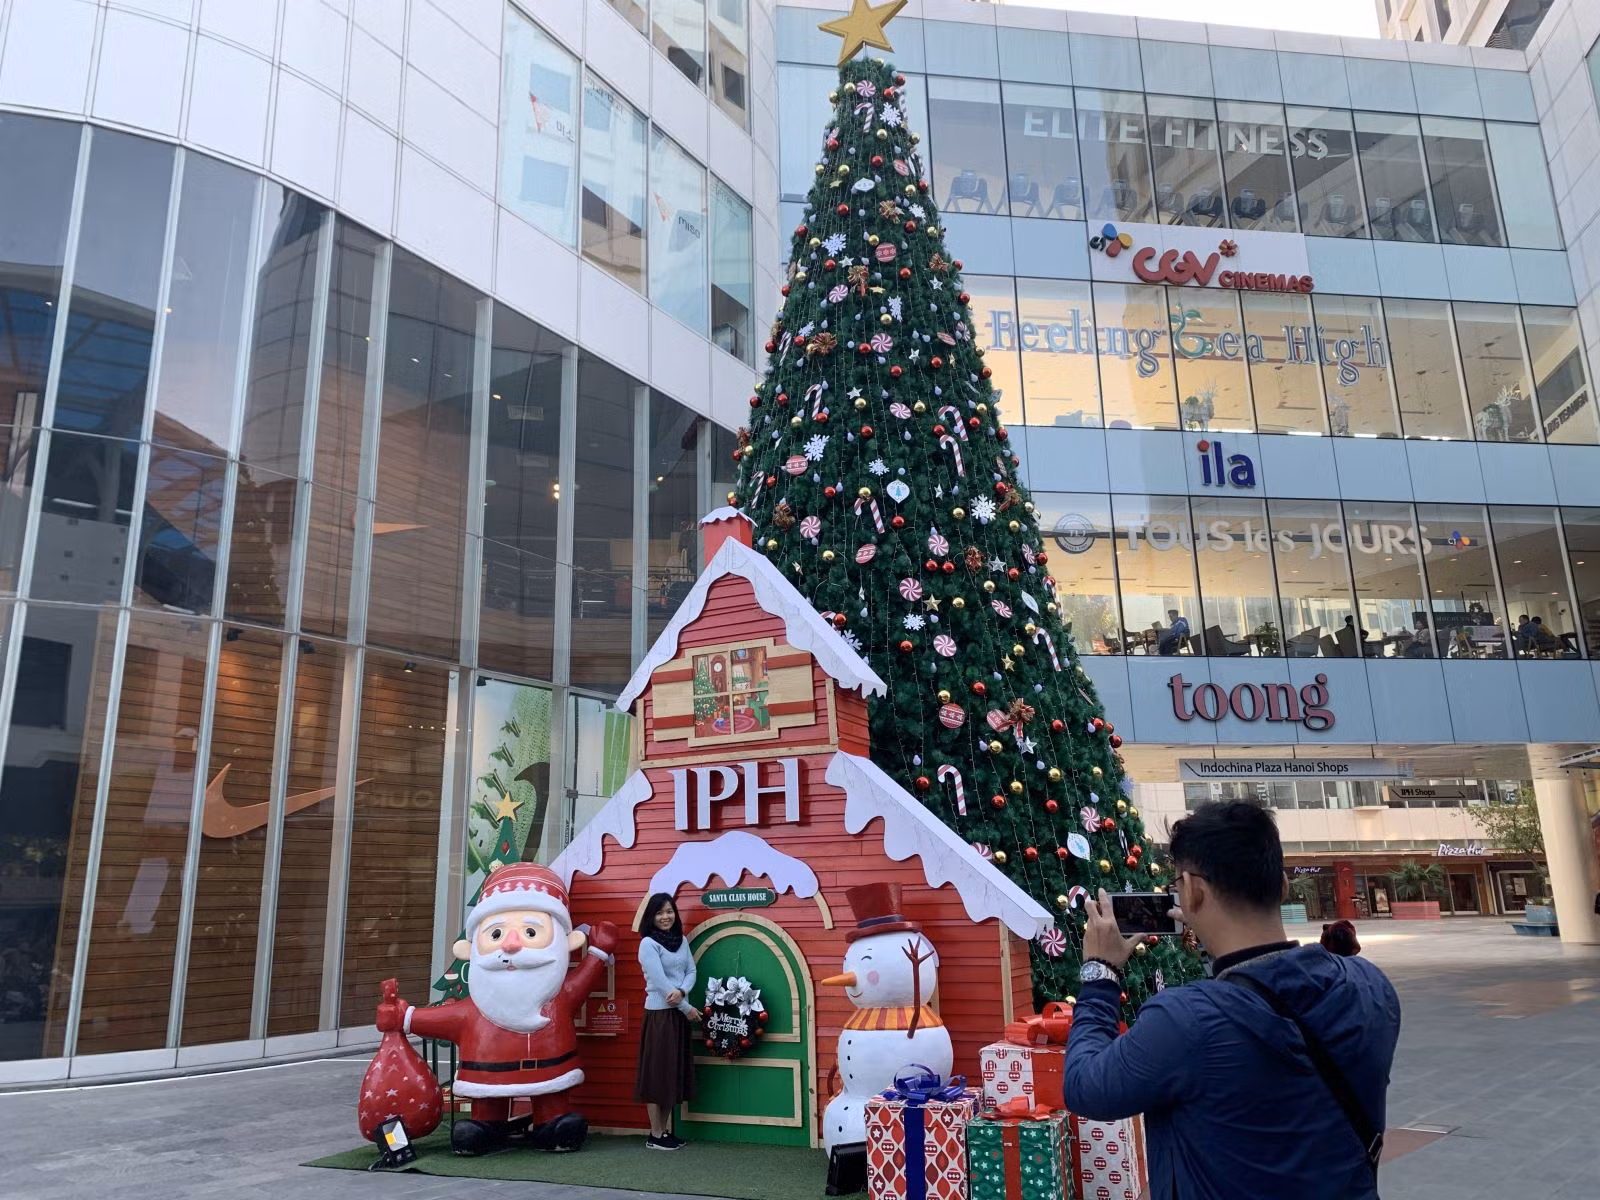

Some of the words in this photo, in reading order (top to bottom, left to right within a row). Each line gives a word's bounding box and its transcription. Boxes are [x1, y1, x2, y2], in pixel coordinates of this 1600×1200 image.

[1024, 108, 1144, 144] ELITE
[1165, 116, 1329, 160] FITNESS
[1132, 246, 1221, 286] CGV
[1218, 270, 1314, 293] CINEMAS
[989, 307, 1162, 378] Feeling
[1281, 325, 1387, 387] High
[1197, 440, 1256, 488] ila
[1118, 520, 1234, 552] TOUS
[1241, 521, 1296, 553] les
[1309, 523, 1433, 560] JOURS
[1167, 673, 1336, 730] toong
[1200, 762, 1253, 773] Indochina
[1255, 762, 1282, 773] Plaza
[1284, 762, 1315, 773] Hanoi
[1317, 762, 1349, 775] Shops
[667, 757, 800, 831] IPH
[1415, 788, 1436, 797] Shops
[1438, 843, 1466, 856] Pizza
[1467, 844, 1488, 856] Hut
[709, 893, 728, 903] SANTA
[728, 893, 747, 902] CLAUS
[747, 892, 767, 902] HOUSE
[707, 1020, 748, 1037] Christmas
[721, 1012, 743, 1027] Merry
